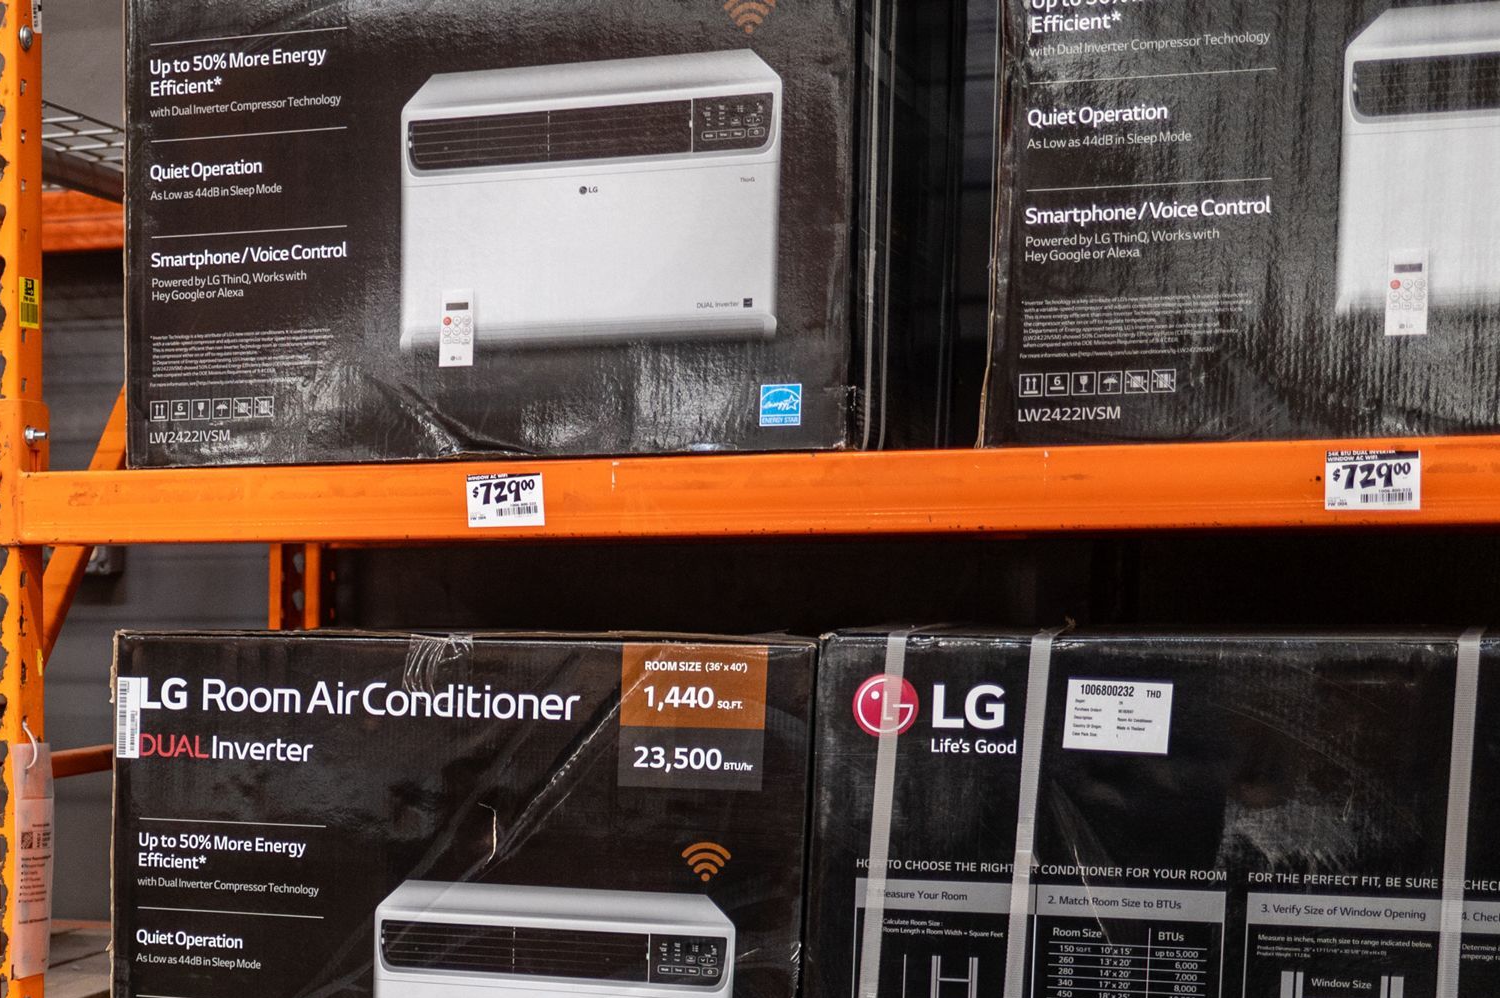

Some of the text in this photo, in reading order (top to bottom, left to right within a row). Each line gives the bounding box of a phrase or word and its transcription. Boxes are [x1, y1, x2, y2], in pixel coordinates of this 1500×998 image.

[150, 48, 326, 76] Up to 50% More Energy
[150, 95, 341, 117] with Dual Inverter Compressor Technology
[1028, 104, 1168, 128] Quiet Operation
[150, 159, 263, 182] Quiet Operation
[150, 184, 282, 200] As Low as 44dB in Sleep Mode
[152, 270, 307, 288] Powered by LG ThinQ, Works with
[150, 429, 230, 443] LW2422IVSM
[645, 661, 677, 671] ROOM
[679, 662, 701, 671] SIZE
[140, 676, 580, 721] LG Room Air Conditioner
[644, 686, 714, 712] 1,440
[1080, 685, 1162, 699] 1006800232 THD
[932, 684, 1005, 729] LG
[139, 732, 313, 762] DUAL Inverter
[931, 738, 1017, 755] Life's Good
[633, 747, 753, 773] 23,500 BTU/hr
[1041, 864, 1228, 881] CONDITIONER FOR YOUR ROOM
[1248, 872, 1438, 889] FOR THE PERFECT FIT, BE SURE
